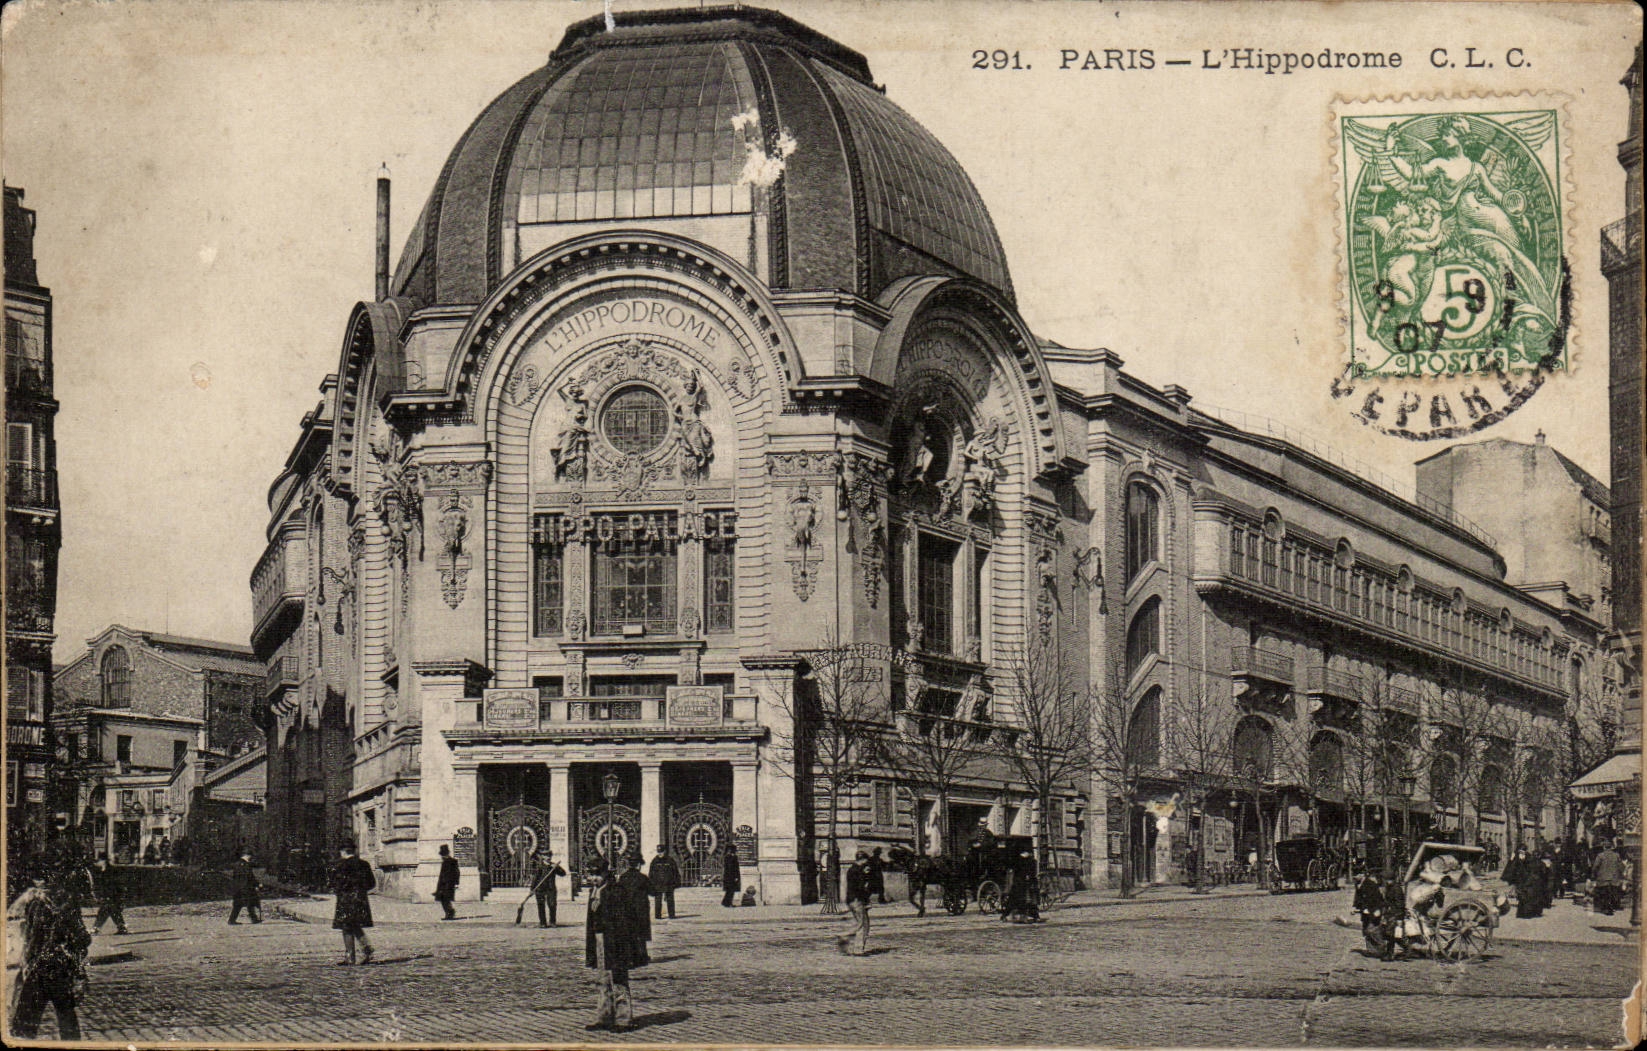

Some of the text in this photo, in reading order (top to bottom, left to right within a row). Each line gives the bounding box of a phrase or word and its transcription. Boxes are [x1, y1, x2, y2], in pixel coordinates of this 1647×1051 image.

[1440, 268, 1477, 334] 5
[1463, 278, 1486, 314] 9
[543, 300, 722, 354] L'HIPPODROME
[1393, 319, 1447, 353] 07
[1413, 351, 1506, 377] POSTES
[530, 511, 737, 544] HIPPO-PALACE
